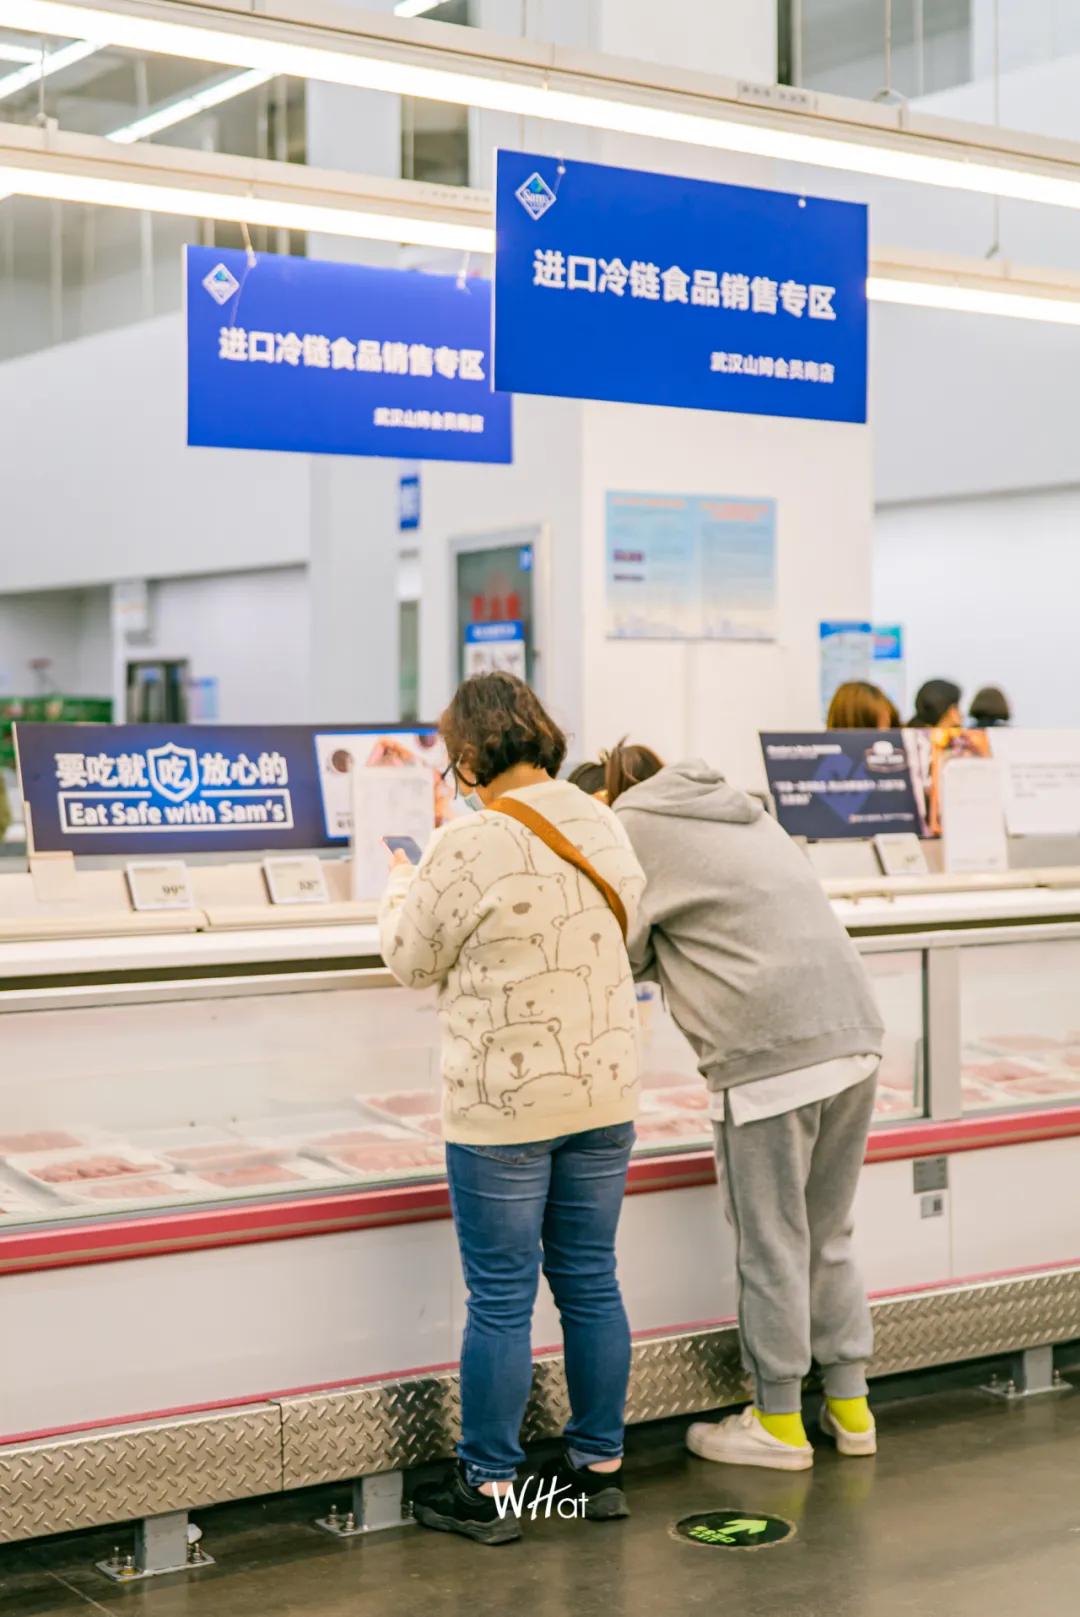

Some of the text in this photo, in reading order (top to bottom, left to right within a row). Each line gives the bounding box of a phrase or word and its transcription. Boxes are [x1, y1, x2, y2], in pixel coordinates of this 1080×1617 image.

[533, 249, 837, 321] 进口冷链食品销售专区
[219, 327, 485, 381] 进口冷链食品销售专区
[69, 799, 286, 826] Eat Safe with Sam's
